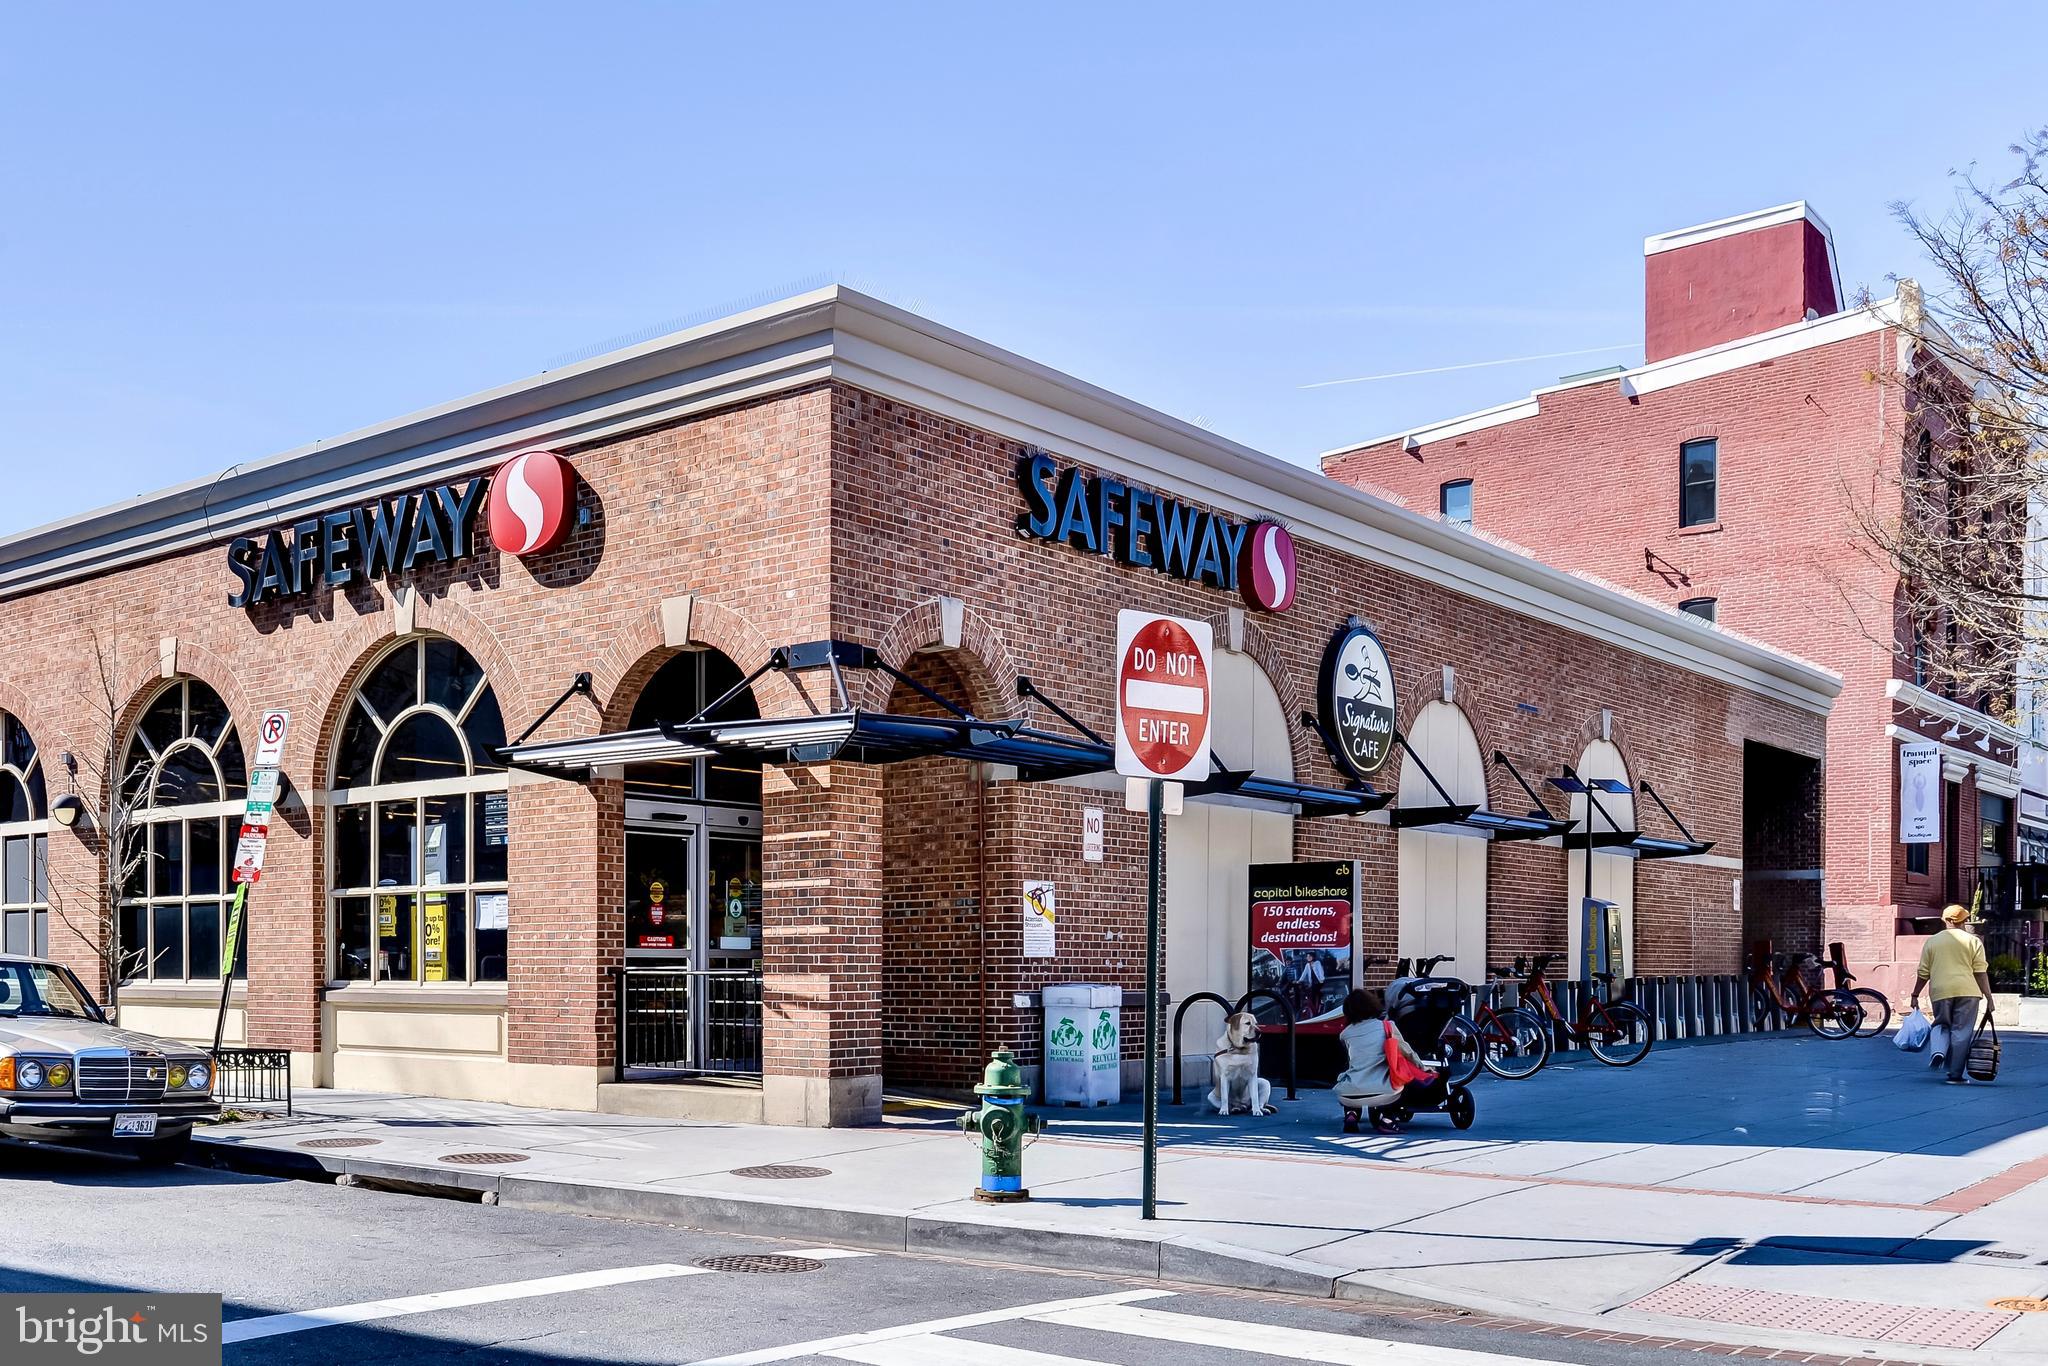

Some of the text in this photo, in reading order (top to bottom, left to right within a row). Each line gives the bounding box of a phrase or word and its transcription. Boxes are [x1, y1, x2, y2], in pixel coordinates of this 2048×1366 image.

[1018, 451, 1248, 591] SAFEWAY
[227, 477, 490, 609] SAFEWAY
[1134, 647, 1197, 678] DO NOT
[1342, 703, 1390, 736] Signature
[1139, 718, 1190, 746] ENTER
[1353, 736, 1379, 760] CAFE
[1903, 747, 1937, 759] tranquil
[1908, 758, 1932, 768] space
[252, 771, 259, 784] 2
[1086, 817, 1100, 834] NO
[1335, 864, 1350, 875] cb
[1253, 885, 1348, 900] capital bikeshare
[1263, 905, 1337, 917] 150 stations,
[425, 923, 441, 937] 0%
[1276, 918, 1321, 930] endless
[425, 936, 441, 946] ore!
[1261, 931, 1338, 943] destinations!
[1050, 1049, 1085, 1057] RECYCLE
[1092, 1052, 1117, 1064] RECYCLE
